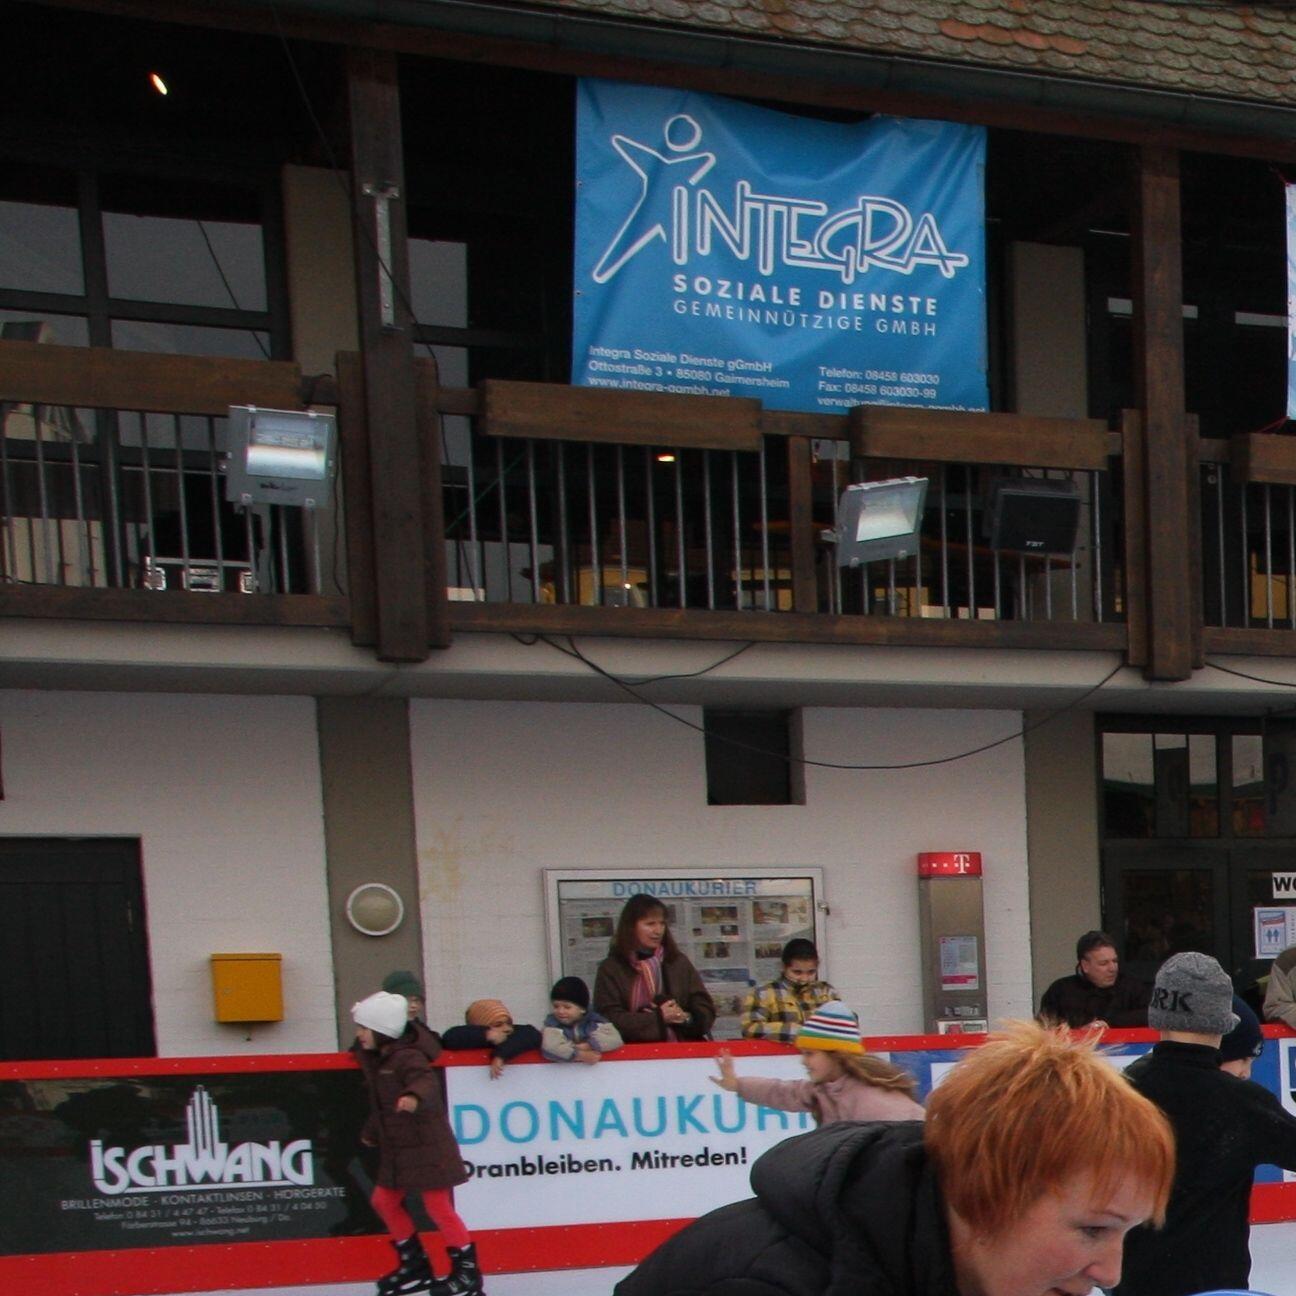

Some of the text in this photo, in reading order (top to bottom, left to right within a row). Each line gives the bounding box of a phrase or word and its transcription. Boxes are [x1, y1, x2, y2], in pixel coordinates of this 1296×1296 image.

[674, 181, 968, 284] INTEGRA
[673, 274, 938, 316] SOZIALE DIENSTE
[673, 300, 937, 336] GEMEINNÜTZIGE GMBH
[589, 345, 772, 373] Integra Soziale Dienste gGmbH
[588, 360, 652, 376] Ottostraße
[655, 366, 663, 377] 3
[715, 371, 790, 389] Gaimersheim
[818, 366, 863, 381] Telefon:
[818, 380, 842, 394] Fax:
[953, 854, 970, 874] T
[613, 880, 757, 897] DONAUKURIER
[630, 1146, 748, 1172] Mitreden!
[61, 1195, 149, 1211] BRILLENMODE
[160, 1189, 264, 1206] KONTAKTLINSEN
